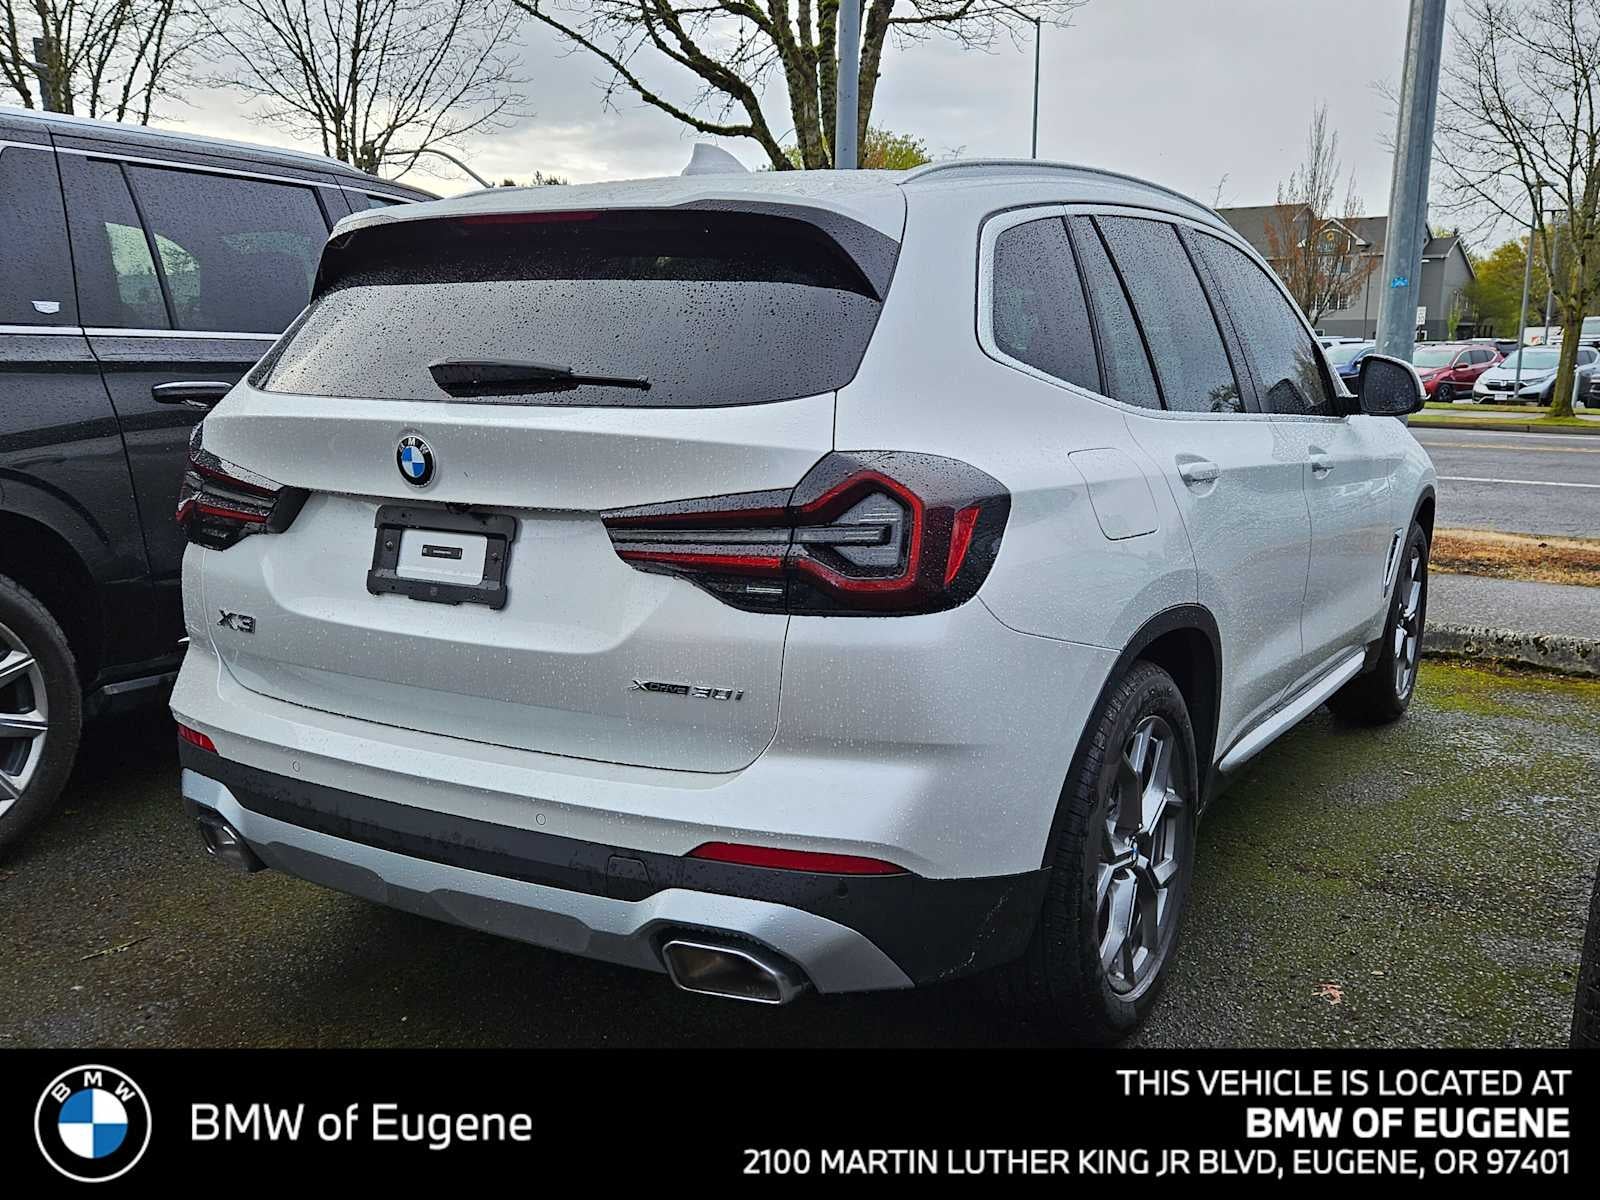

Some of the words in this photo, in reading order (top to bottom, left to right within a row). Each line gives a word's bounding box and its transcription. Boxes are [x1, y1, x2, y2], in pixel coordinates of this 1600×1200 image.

[399, 436, 430, 455] BMW
[217, 609, 256, 633] X3
[692, 685, 744, 701] 30i
